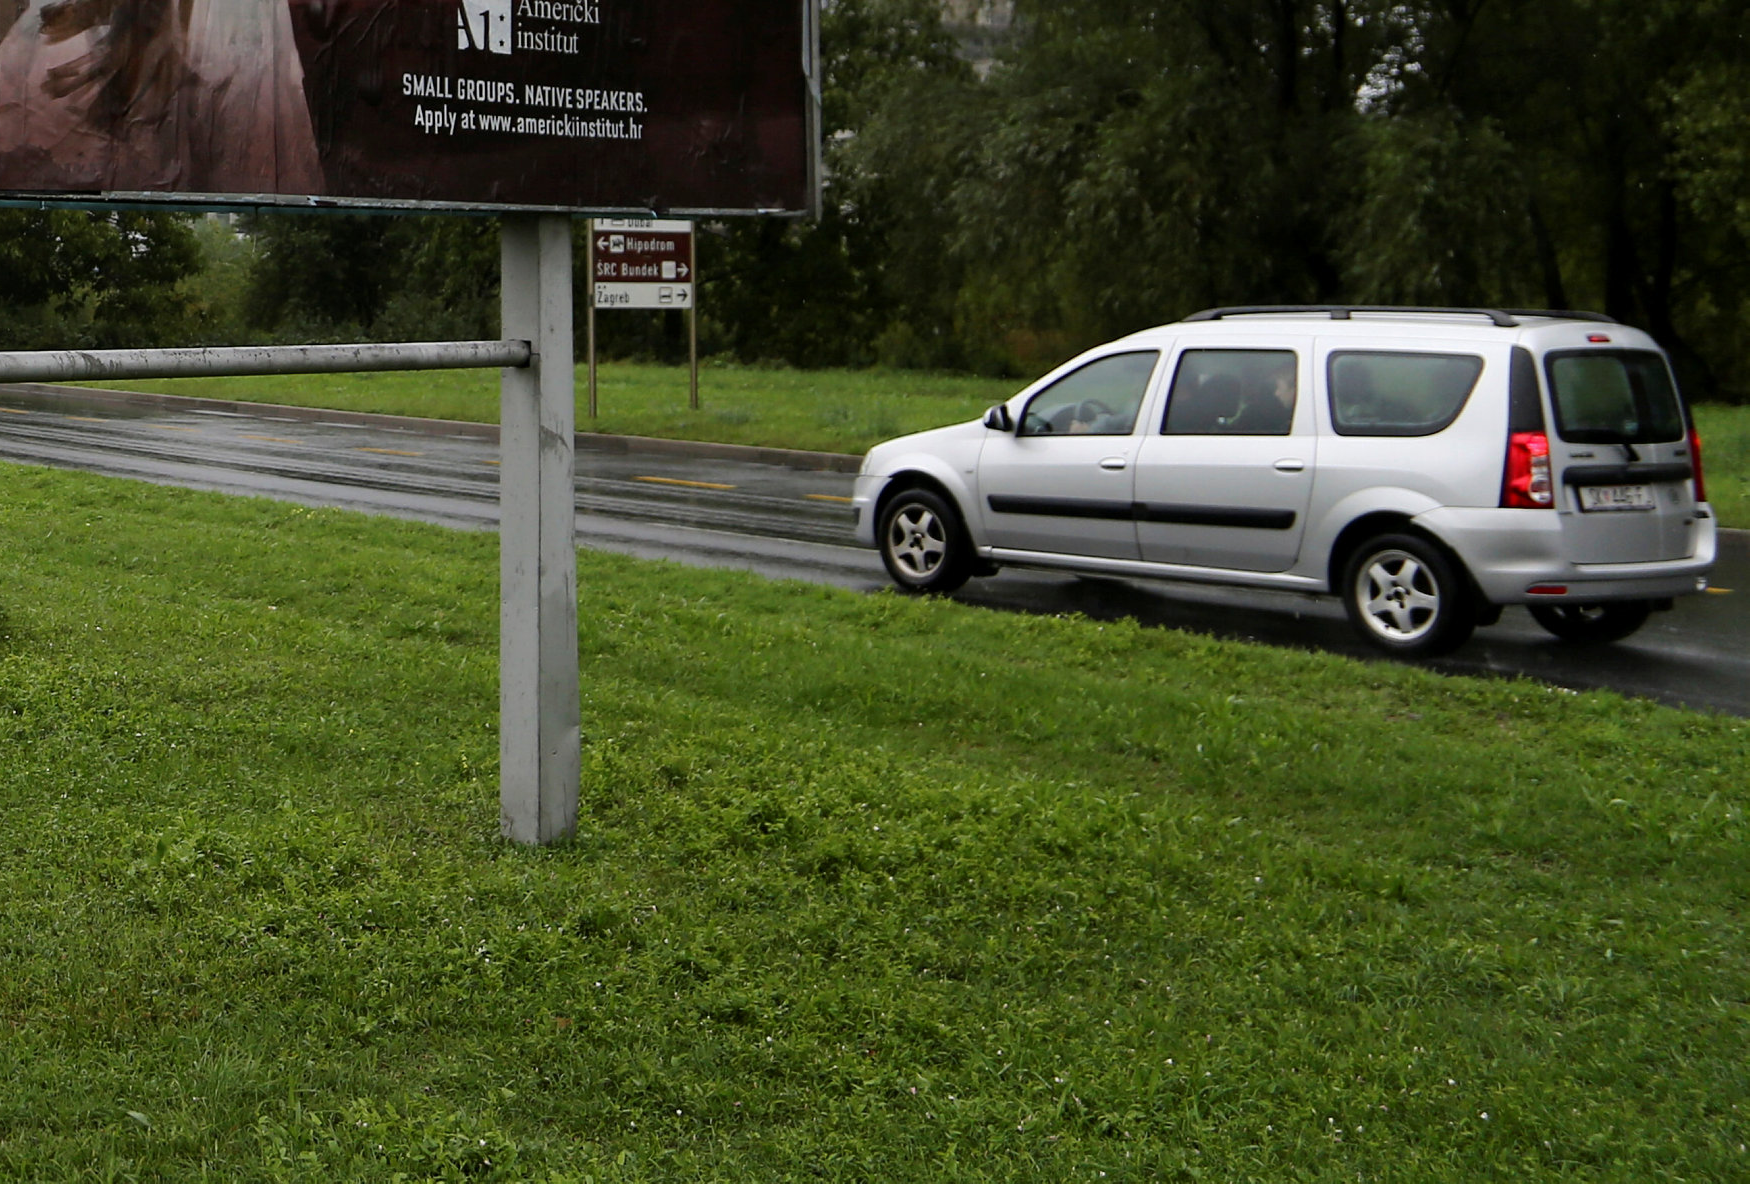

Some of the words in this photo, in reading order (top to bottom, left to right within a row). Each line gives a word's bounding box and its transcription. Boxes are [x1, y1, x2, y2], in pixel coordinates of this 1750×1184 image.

[516, 22, 579, 55] institut
[402, 73, 453, 100] SMALL
[457, 78, 520, 105] GROUPS.
[525, 84, 573, 109] NATIVE
[576, 88, 648, 113] SPEAKERS.
[414, 103, 457, 136] Apply
[461, 109, 476, 130] at
[626, 237, 675, 253] Hipodrom
[621, 262, 659, 276] Bundek
[597, 291, 630, 306] Zagreb
